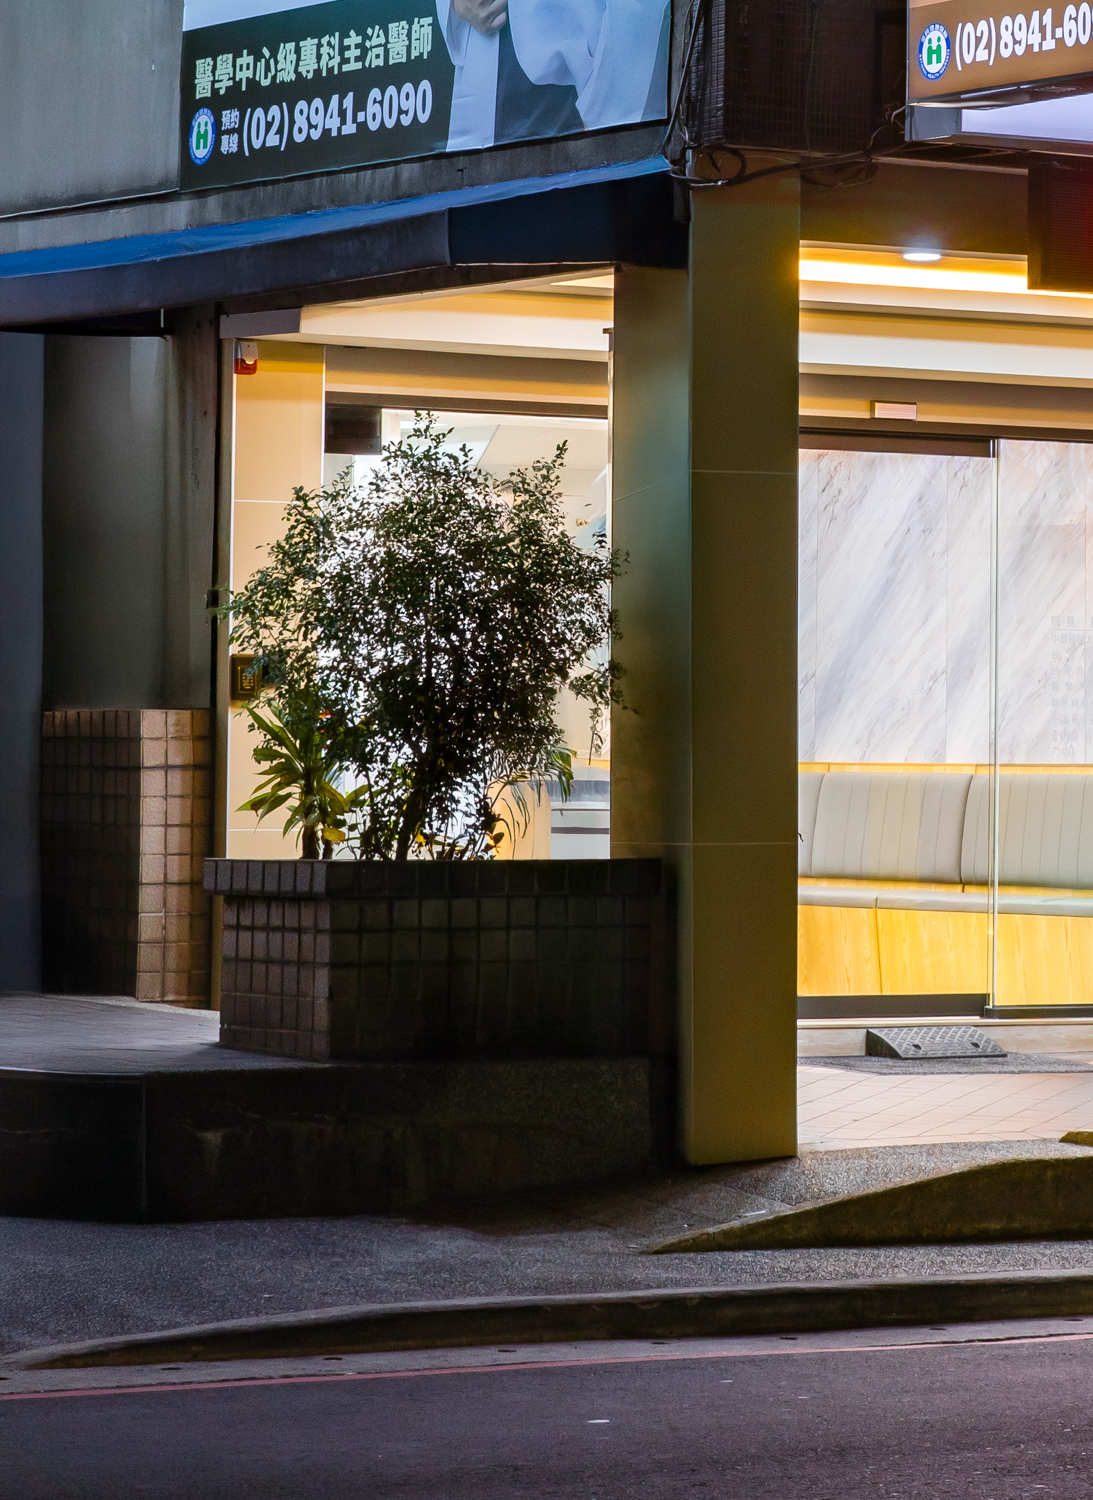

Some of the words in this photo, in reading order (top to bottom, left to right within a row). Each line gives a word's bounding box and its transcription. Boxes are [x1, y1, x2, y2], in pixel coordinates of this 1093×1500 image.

[194, 16, 433, 100] 醫學中心級專科主治醫師
[221, 108, 240, 131] 預約
[220, 132, 239, 155] 專線
